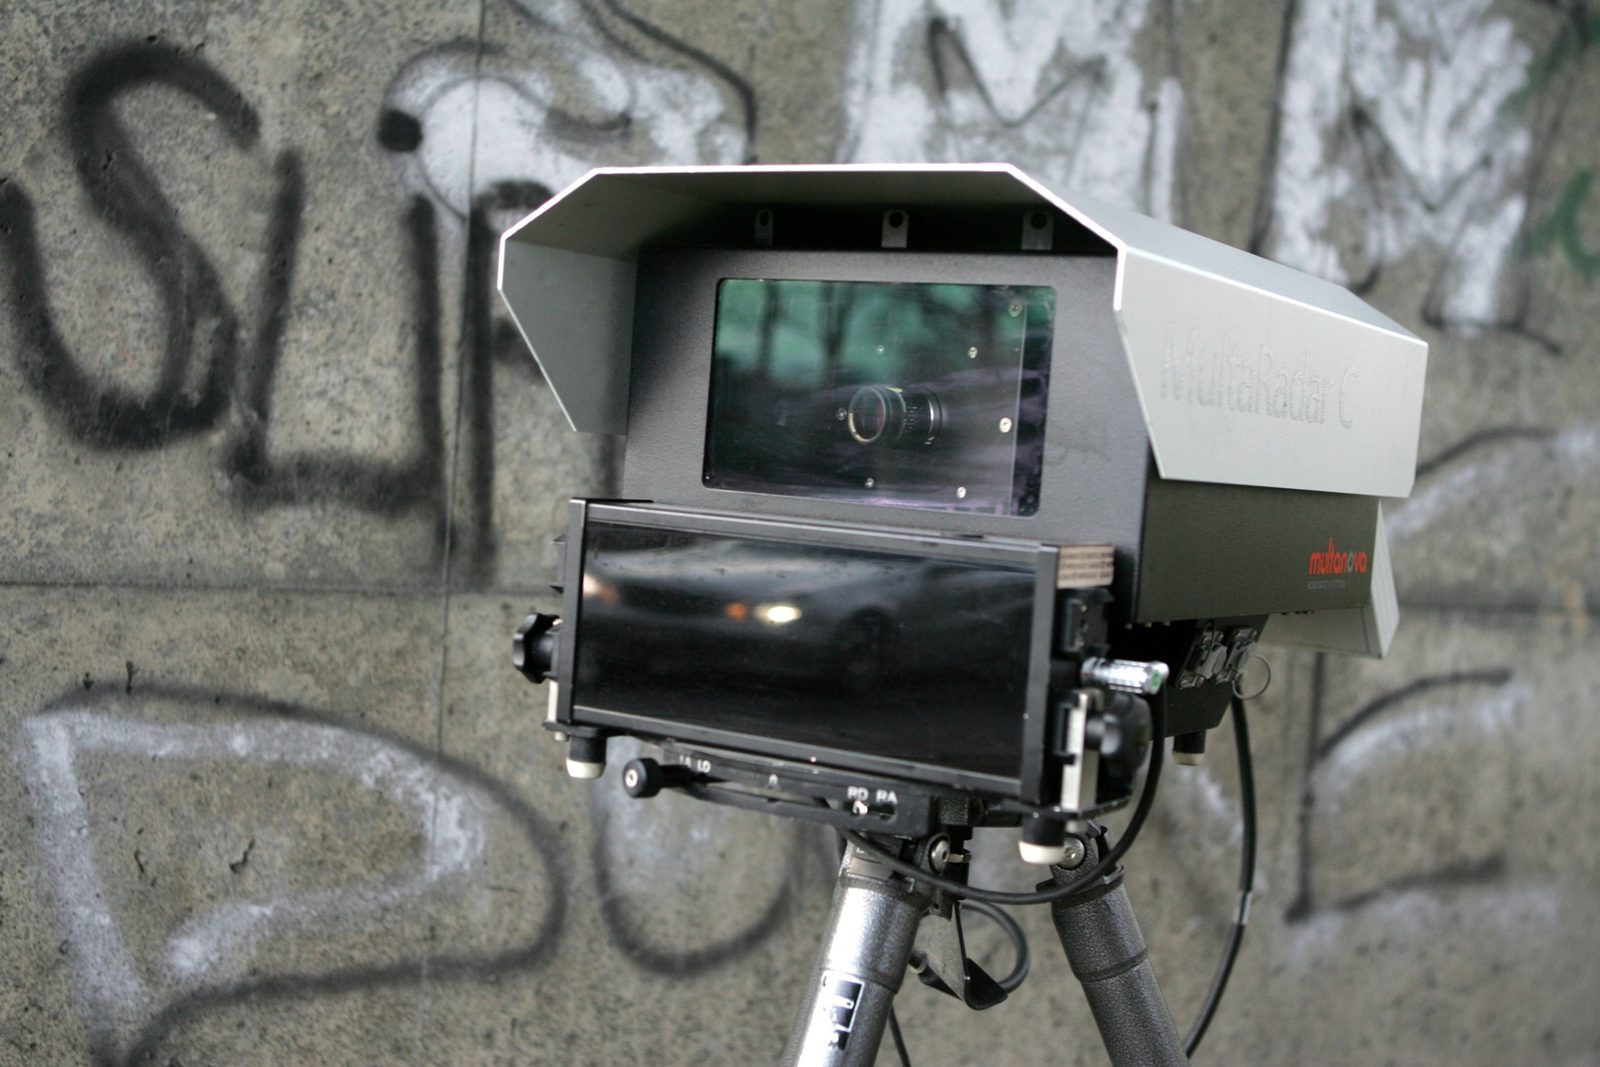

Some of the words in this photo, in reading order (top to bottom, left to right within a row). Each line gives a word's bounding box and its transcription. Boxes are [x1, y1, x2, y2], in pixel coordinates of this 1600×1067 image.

[1161, 322, 1334, 424] MultaRadar
[1338, 365, 1358, 430] C
[1308, 536, 1368, 576] multanova
